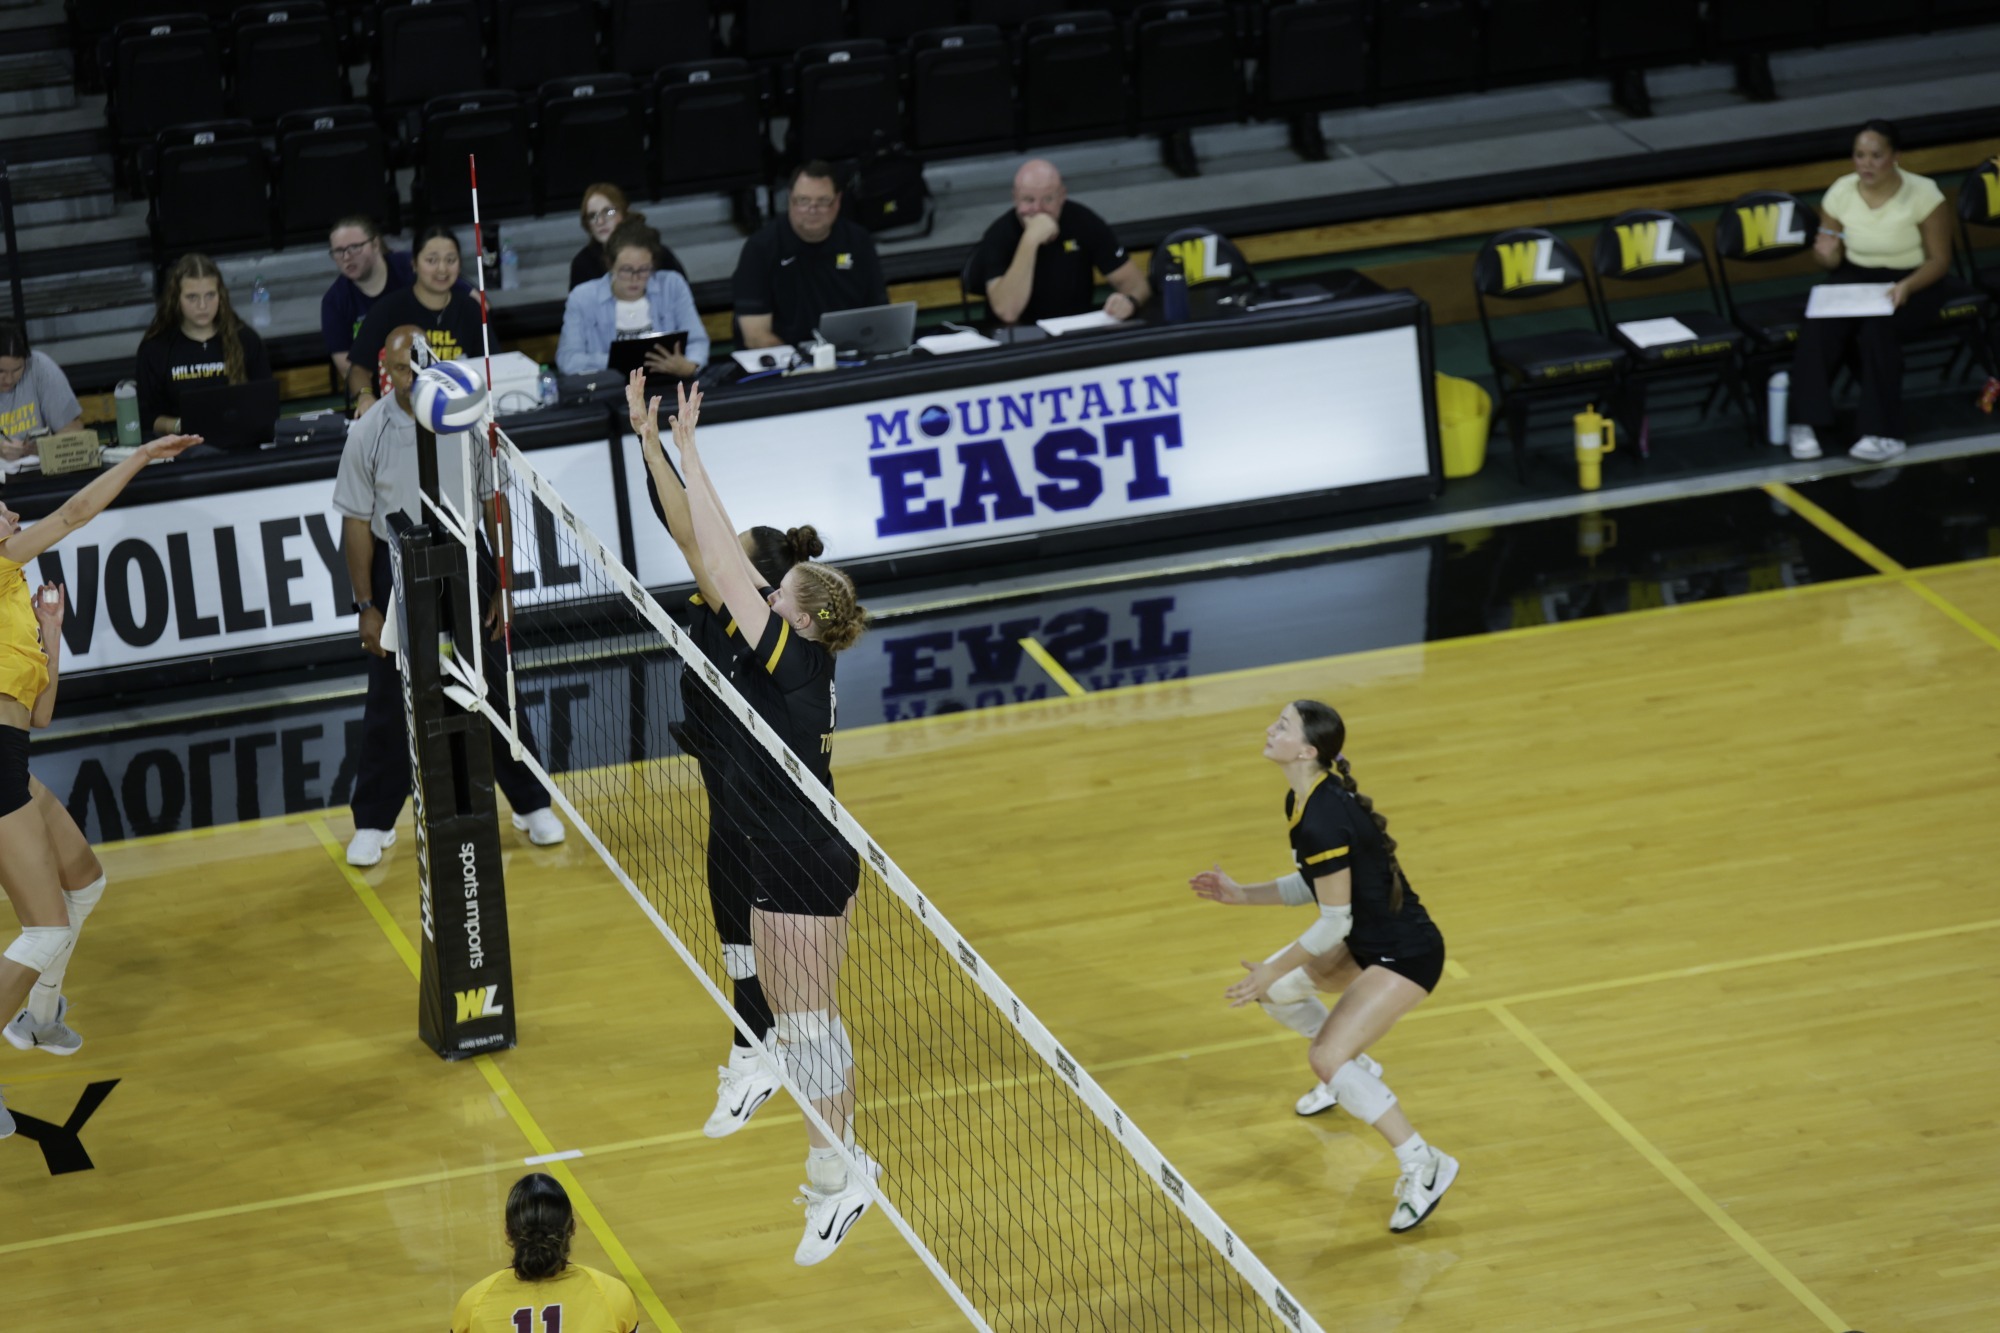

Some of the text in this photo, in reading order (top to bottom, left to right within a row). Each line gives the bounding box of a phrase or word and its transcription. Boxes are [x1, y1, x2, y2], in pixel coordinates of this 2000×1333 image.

[1615, 218, 1685, 274] WL
[1736, 201, 1806, 254] WL
[1496, 238, 1565, 290] WL
[426, 329, 457, 346] IRL
[172, 361, 226, 381] HILLTOPP
[0, 402, 34, 428] IBERTY
[866, 371, 1180, 449] MOUNTAIN
[869, 413, 1183, 538] EAST
[459, 842, 483, 970] sports imports
[454, 984, 504, 1024] WL
[511, 1303, 562, 1333] 11
